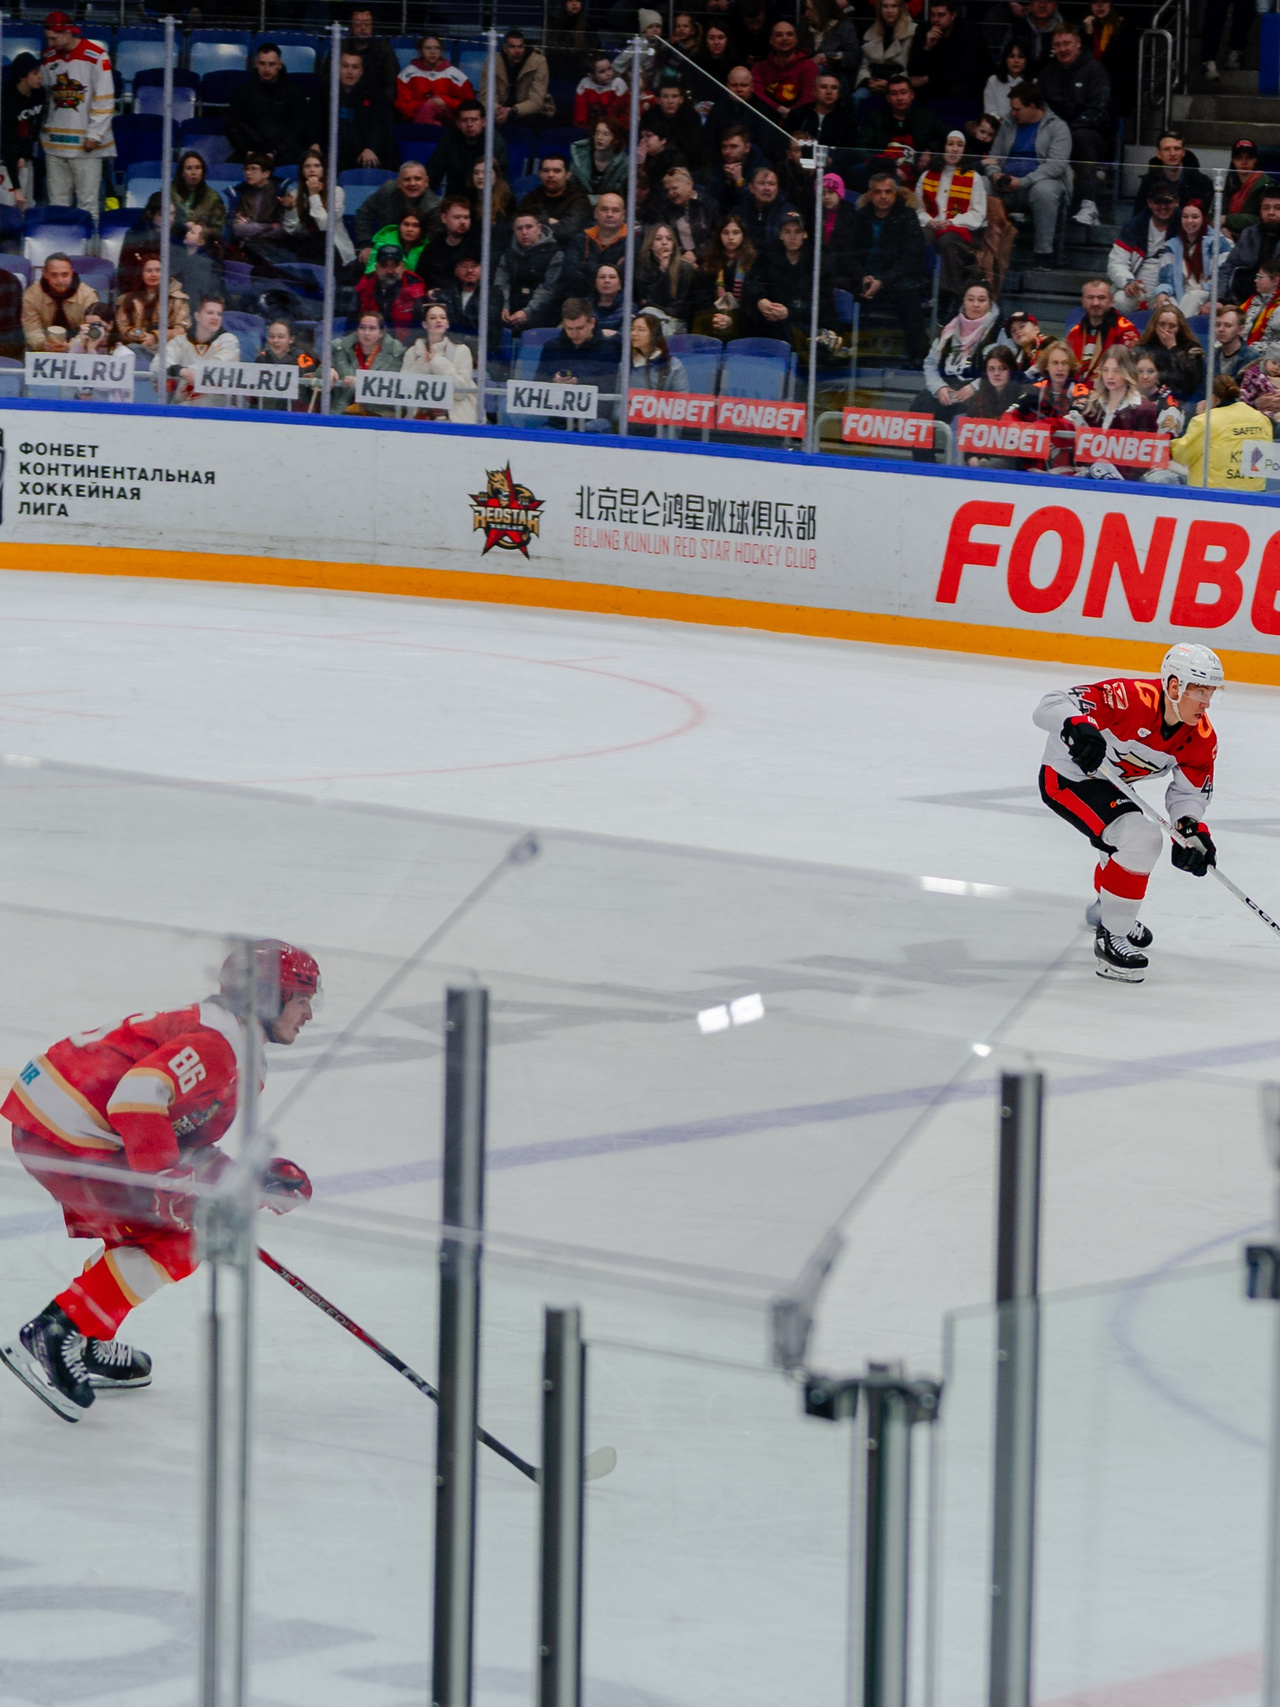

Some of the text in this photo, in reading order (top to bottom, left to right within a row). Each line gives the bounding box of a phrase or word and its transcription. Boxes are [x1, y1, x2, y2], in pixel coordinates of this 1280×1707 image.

[33, 358, 127, 382] KHL.RU
[200, 367, 291, 393] KHL.RU
[361, 376, 447, 401] KHL.RU
[513, 386, 592, 412] KHL.RU
[628, 394, 714, 425] FONBET
[717, 404, 805, 437] FONBET
[843, 414, 933, 441] FONBET
[958, 423, 1050, 452] FONBET
[1232, 427, 1263, 436] SAFETY
[18, 441, 99, 459] ФОНБЕТ
[1076, 433, 1169, 462] FONBET
[19, 461, 216, 485] КОНТИНЕНТАЛЬНАЯ
[19, 481, 141, 500] ХОККЕЙНАЯ
[18, 502, 69, 517] ЛИГА
[469, 504, 545, 538] REDSTAR
[575, 484, 817, 541] 北京昆仑鸿星冰球俱乐部
[573, 525, 817, 570] BEIJING KUNLUN RED STAR HOCKEY CLUB
[168, 1046, 206, 1094] 86
